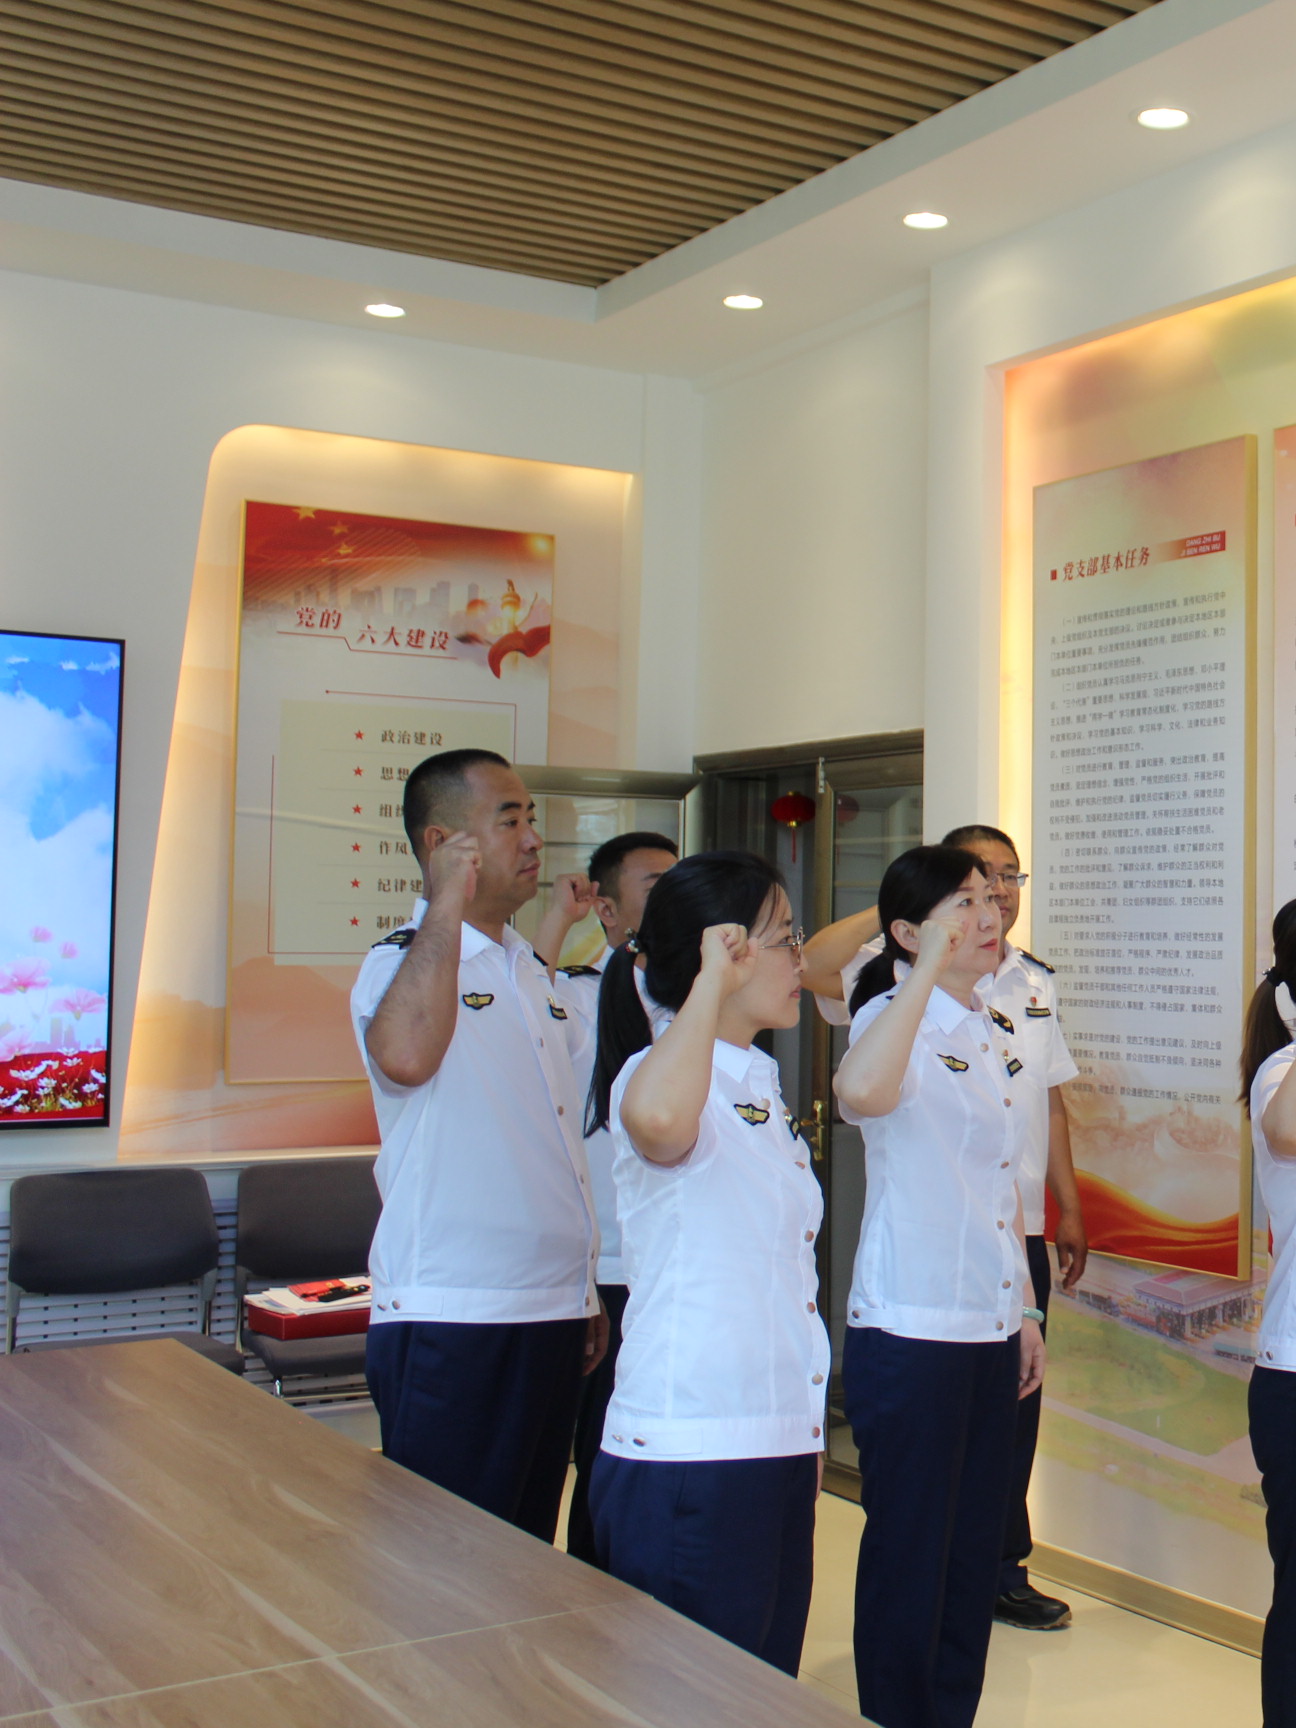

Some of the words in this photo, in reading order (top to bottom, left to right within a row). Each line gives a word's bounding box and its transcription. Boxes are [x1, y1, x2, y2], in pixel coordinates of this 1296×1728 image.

[1063, 547, 1150, 581] 党支部基本任务
[296, 607, 342, 630] 党的
[356, 624, 449, 650] 六大建设
[381, 730, 442, 746] 政治建设
[380, 841, 407, 855] 作风
